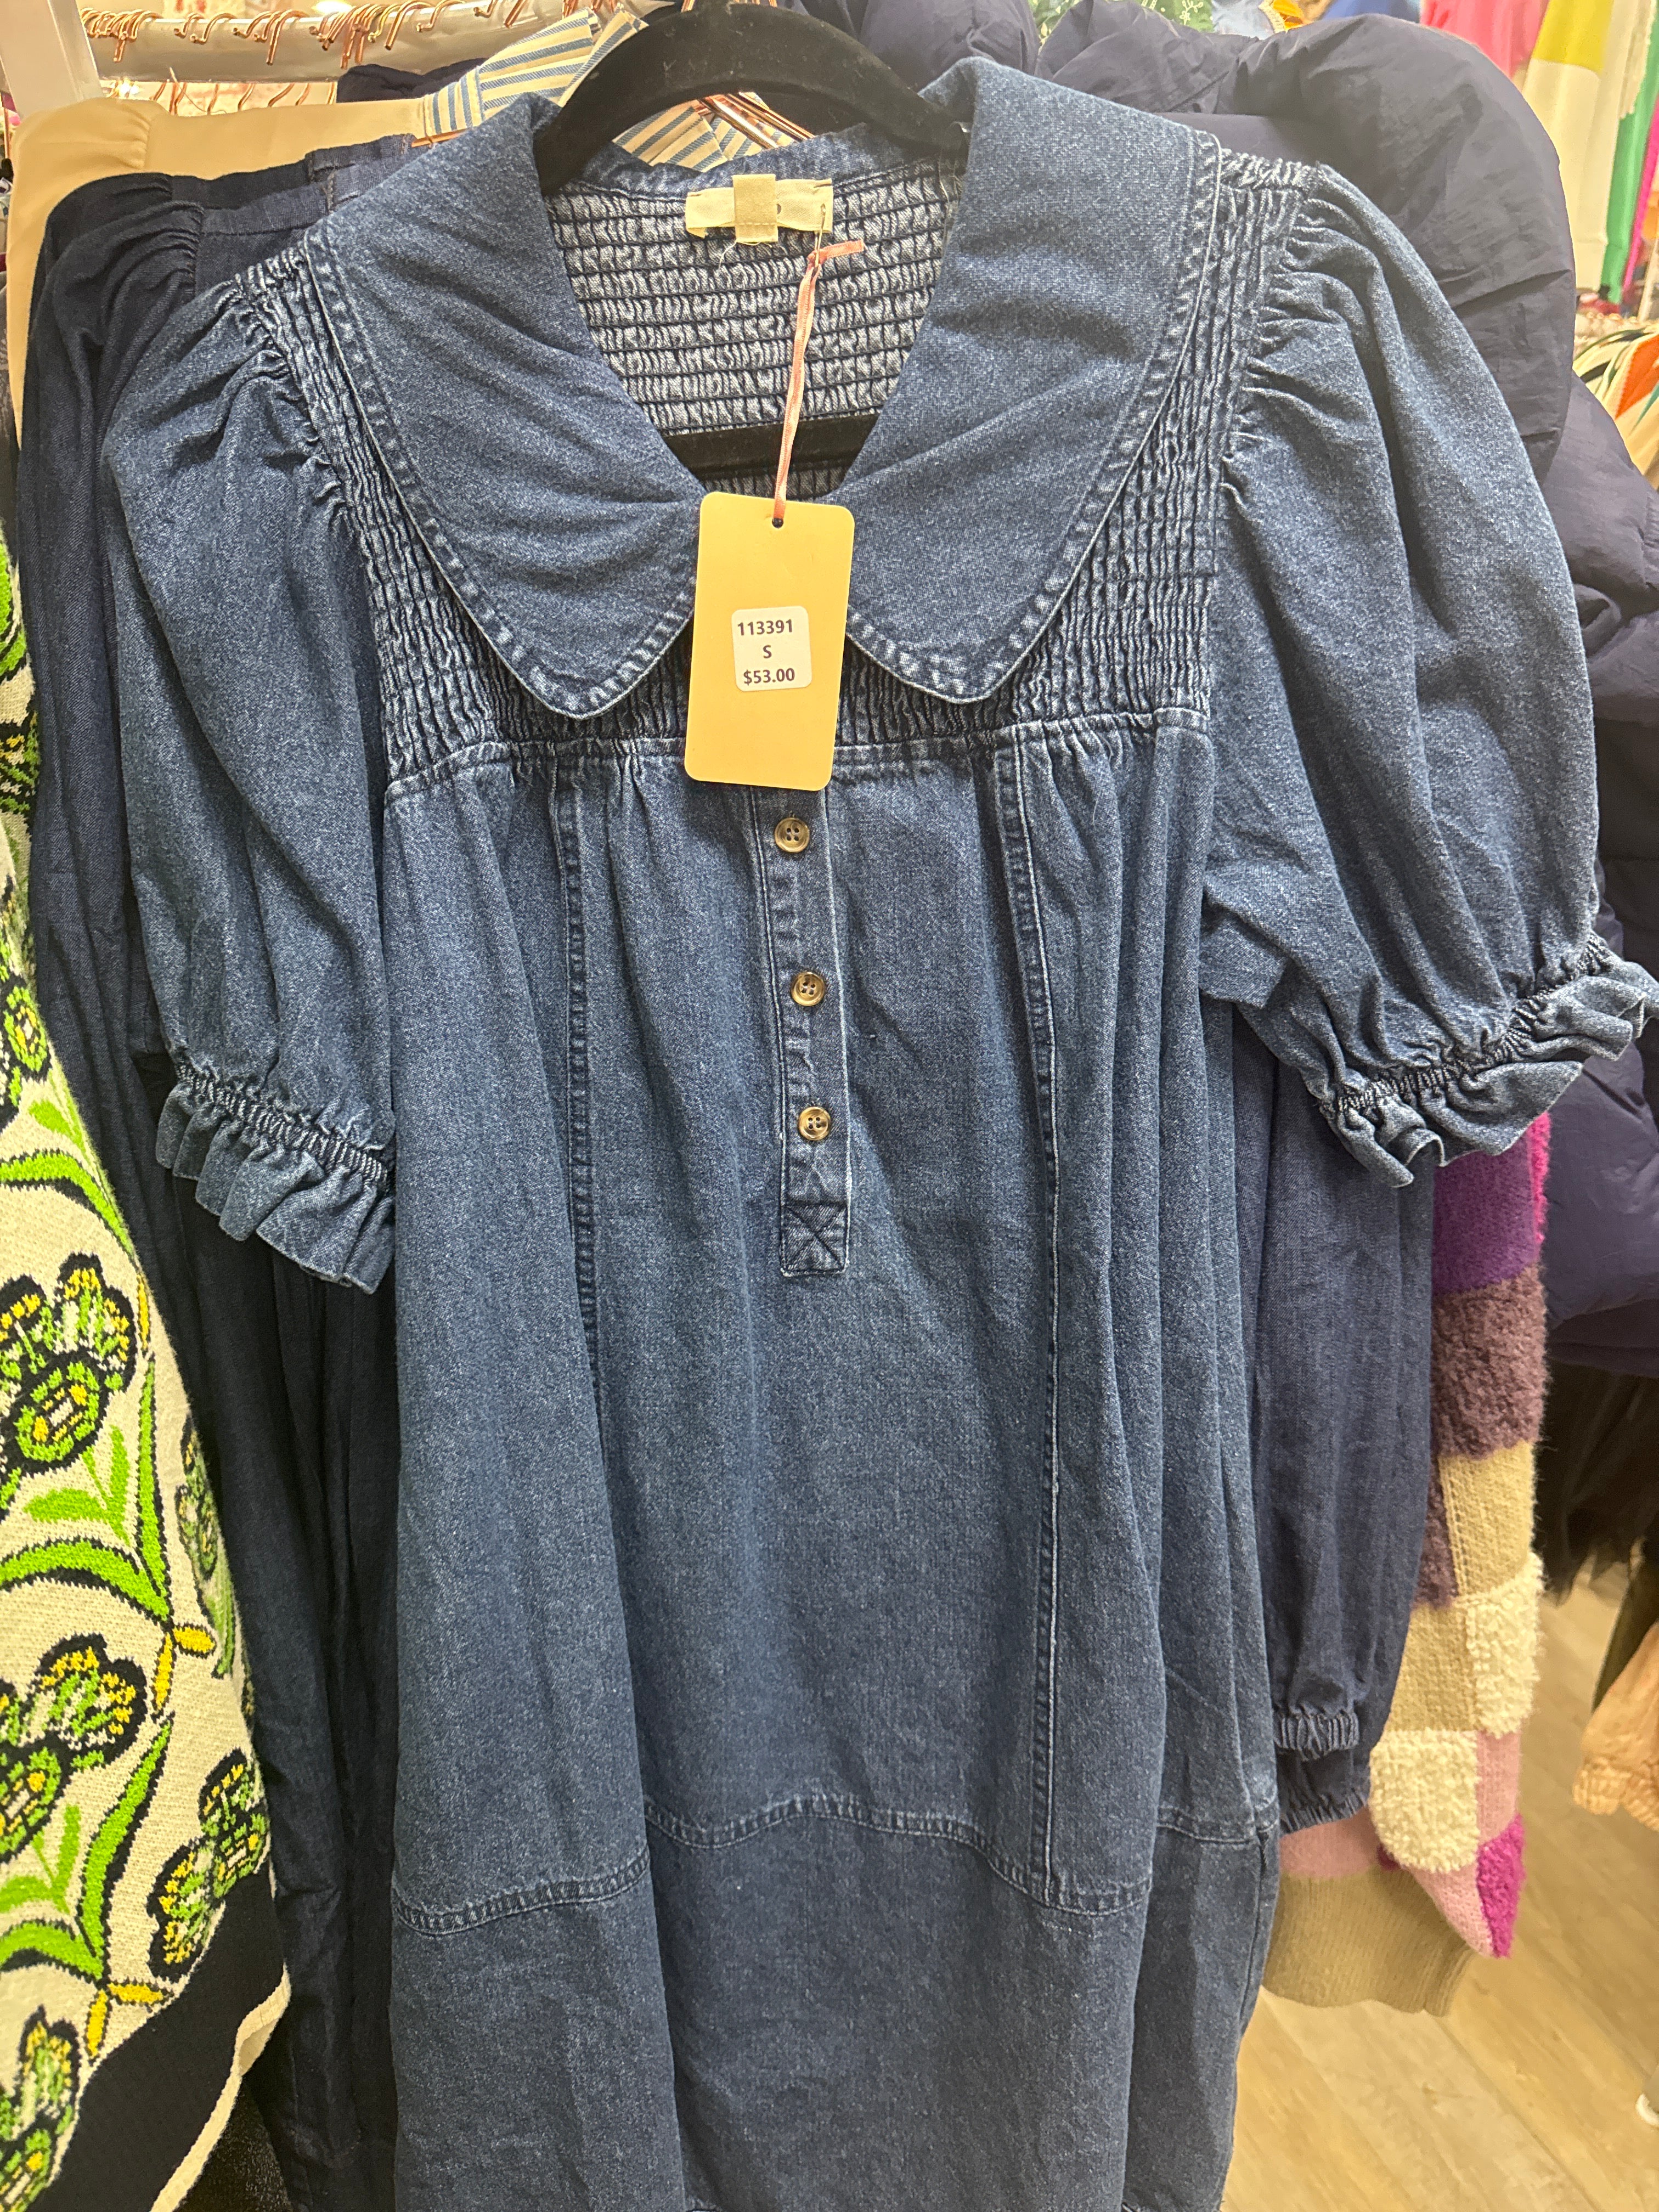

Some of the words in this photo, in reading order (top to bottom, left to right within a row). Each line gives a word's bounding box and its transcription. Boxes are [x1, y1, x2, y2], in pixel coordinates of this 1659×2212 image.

[737, 619, 792, 636] 113391
[763, 645, 772, 659] S
[743, 668, 795, 686] $53.00
